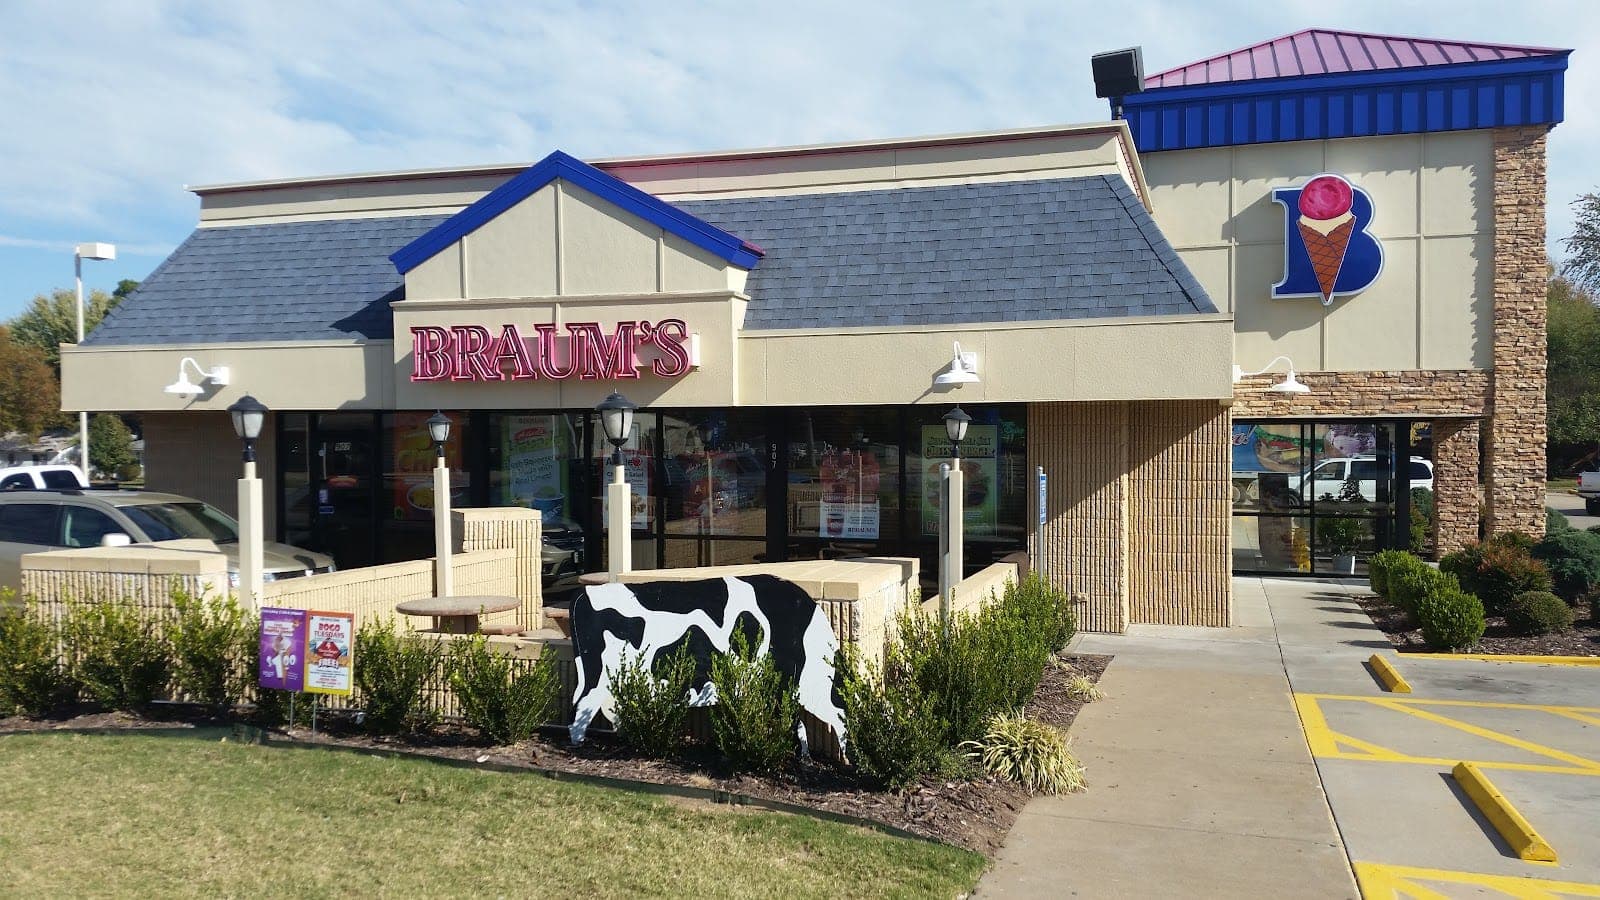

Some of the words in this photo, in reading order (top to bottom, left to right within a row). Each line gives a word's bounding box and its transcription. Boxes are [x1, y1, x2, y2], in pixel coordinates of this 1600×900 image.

[410, 319, 693, 381] BRAUM'S
[606, 456, 633, 466] Ale
[318, 622, 341, 632] BOGO
[314, 630, 345, 639] TUESDAYS
